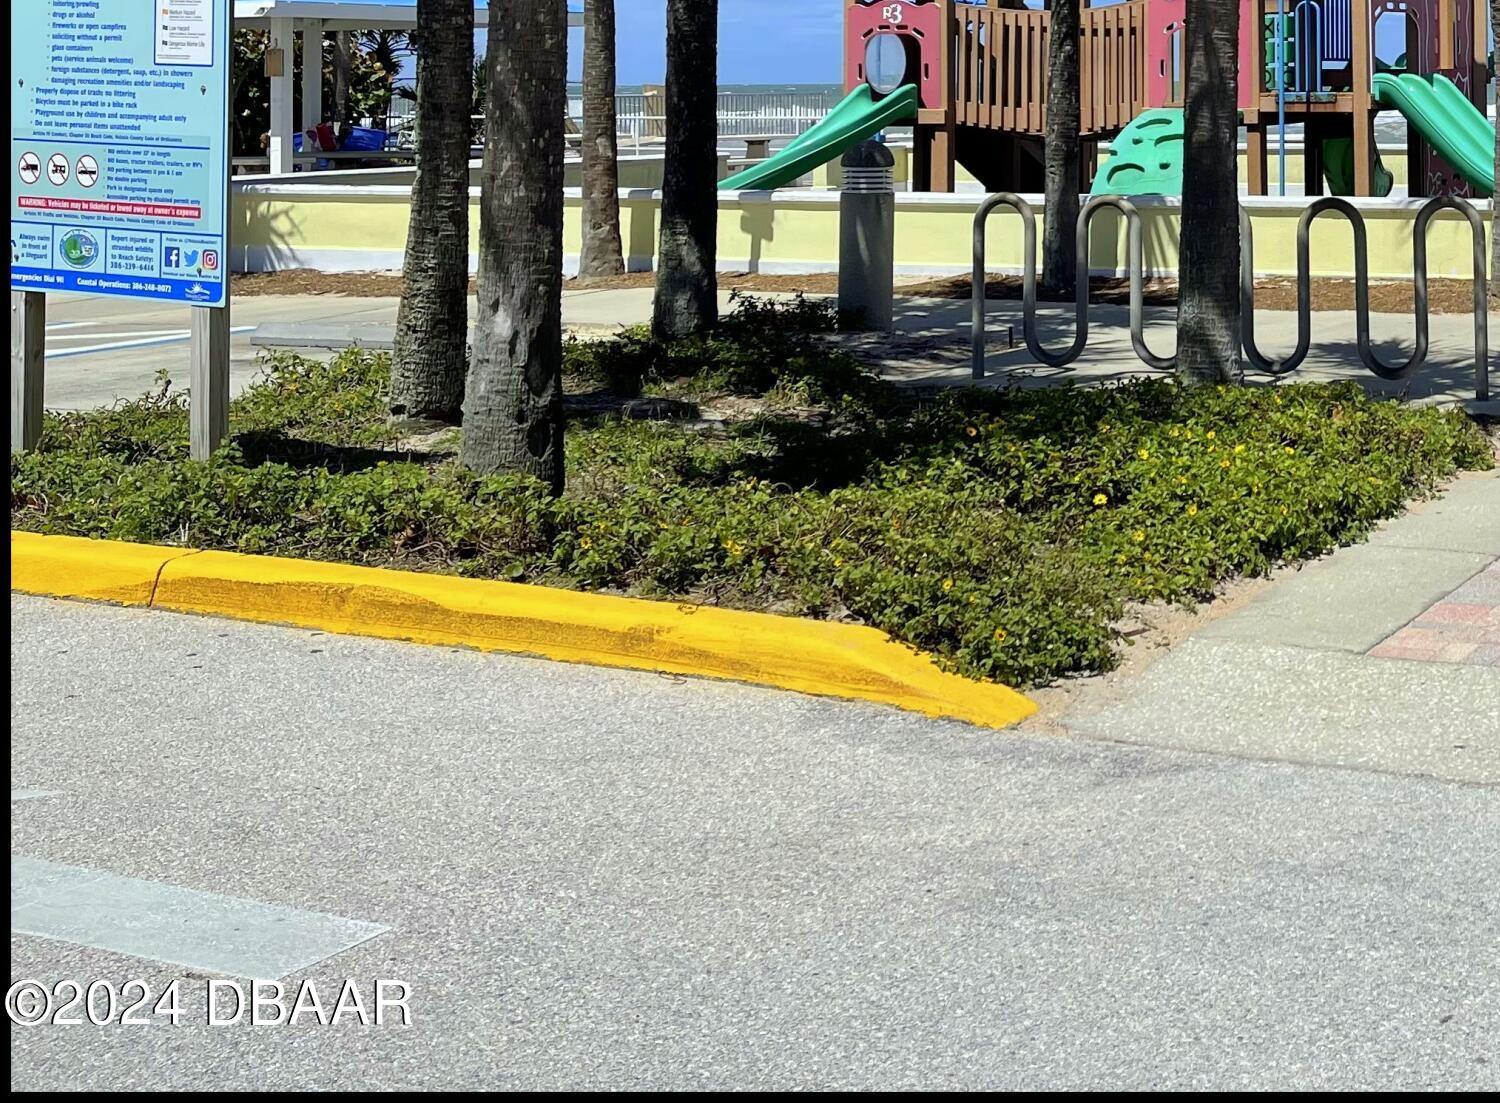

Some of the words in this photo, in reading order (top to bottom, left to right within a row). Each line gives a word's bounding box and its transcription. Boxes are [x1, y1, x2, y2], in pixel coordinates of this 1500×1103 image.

[52, 44, 64, 52] glass
[36, 87, 58, 96] Properly
[60, 88, 79, 96] dispose
[36, 98, 56, 106] Bicycles
[80, 100, 98, 108] parked
[36, 109, 64, 117] Playground
[174, 115, 186, 123] only
[20, 197, 46, 207] WARNING:
[48, 199, 70, 208] Vehicles
[70, 201, 81, 210] may
[82, 202, 88, 210] be
[133, 206, 148, 214] away
[44, 274, 54, 282] Dial
[77, 278, 98, 286] Coastal
